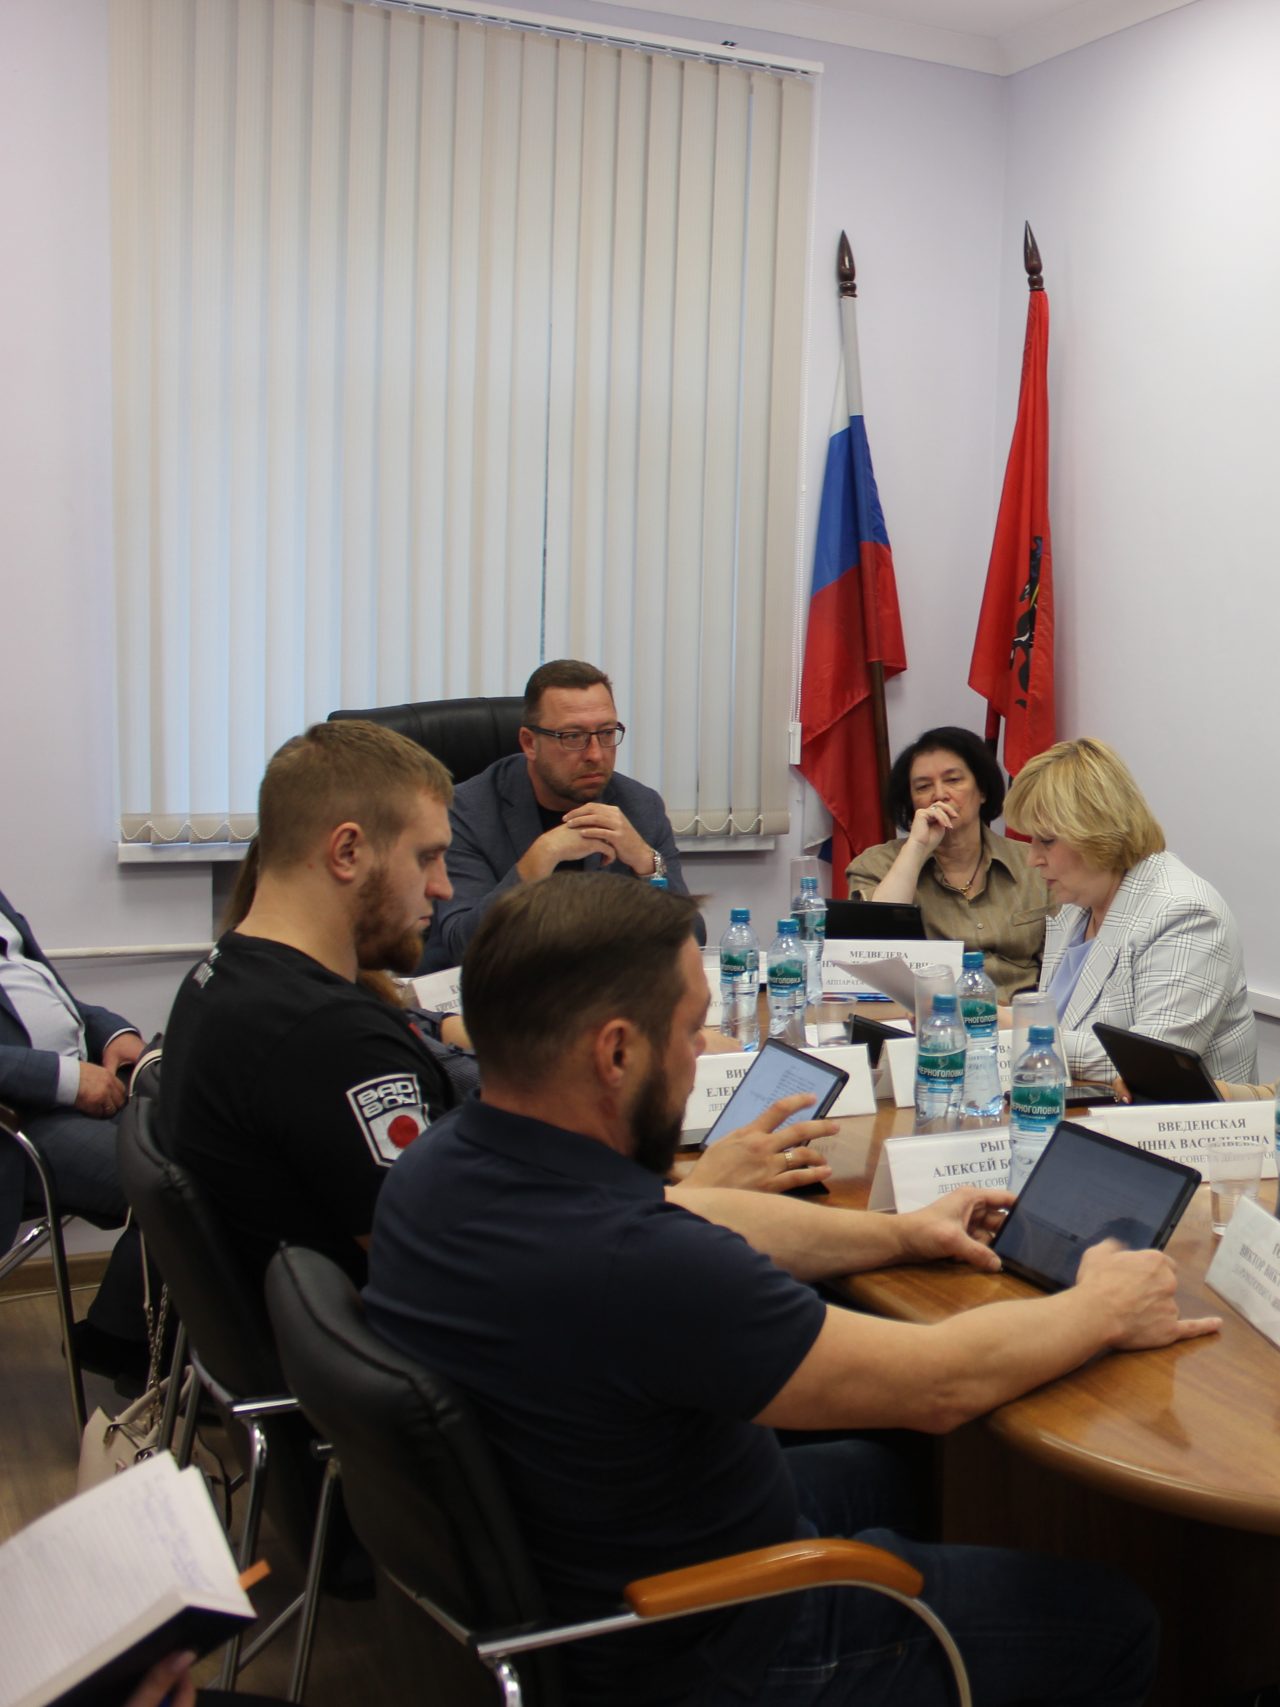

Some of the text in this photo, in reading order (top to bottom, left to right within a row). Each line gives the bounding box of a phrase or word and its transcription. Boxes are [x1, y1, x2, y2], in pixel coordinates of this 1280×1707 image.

[357, 1081, 414, 1106] BAD
[1012, 1102, 1060, 1115] ЕРНОГОЛОВКА
[1158, 1118, 1246, 1133] ВВЕДЕНСКАЯ
[1137, 1139, 1177, 1151] ИННА
[933, 1157, 996, 1178] АЛЕКСЕЙ
[985, 1176, 1009, 1188] СОВЕ
